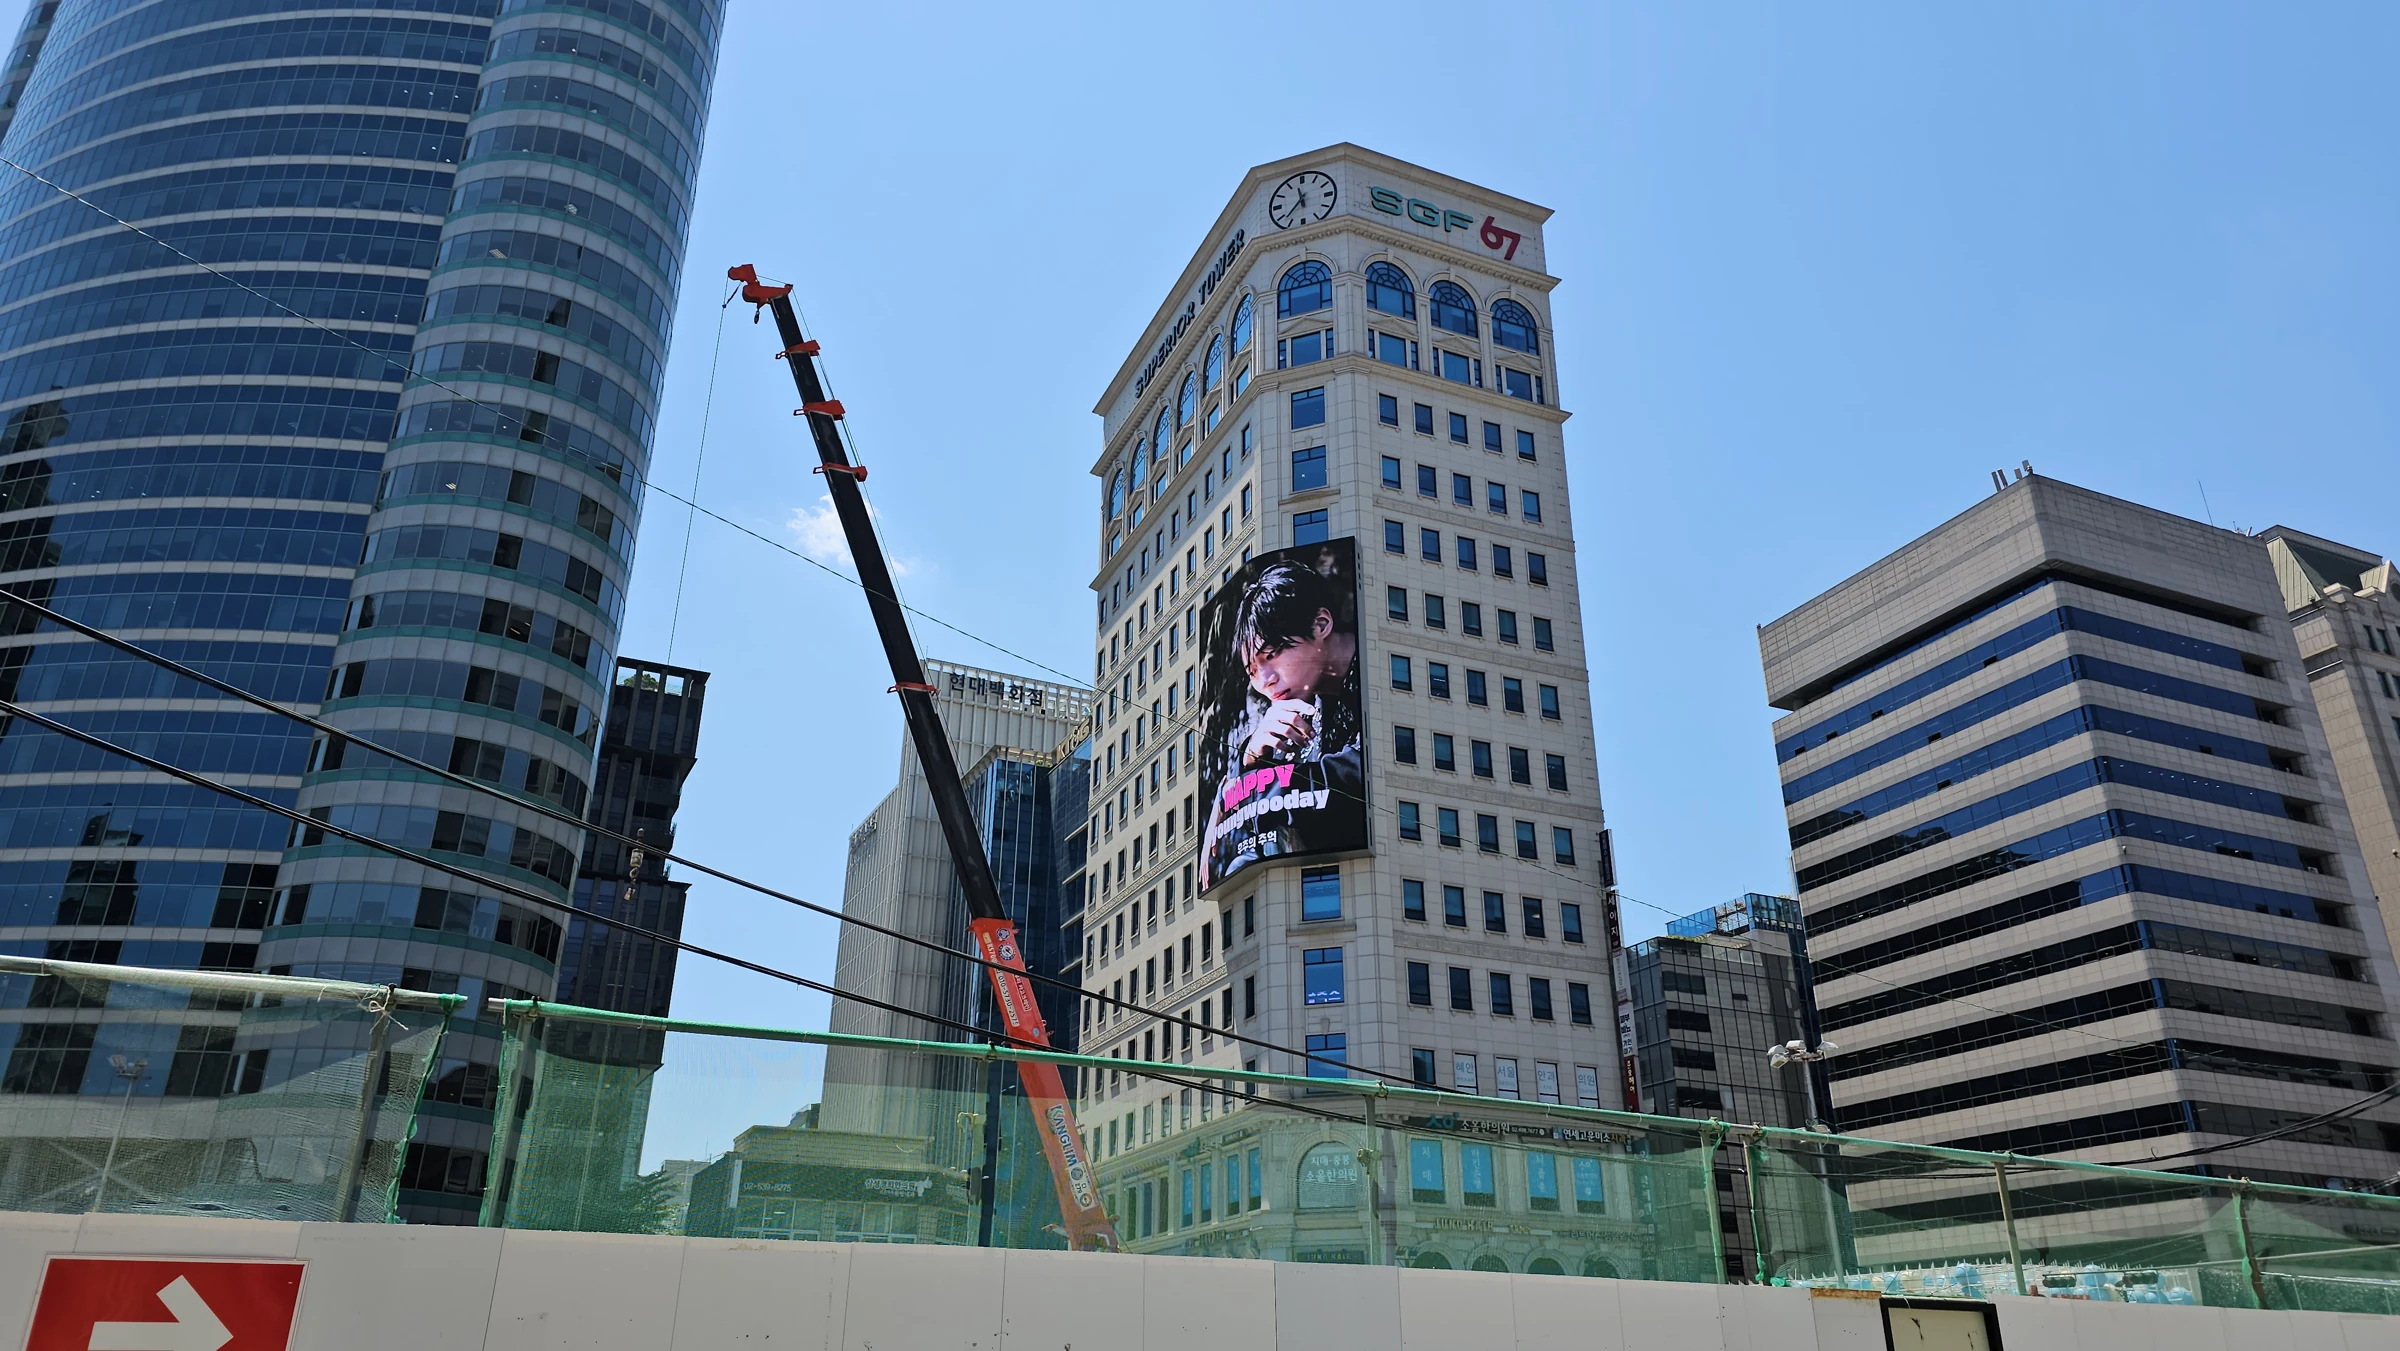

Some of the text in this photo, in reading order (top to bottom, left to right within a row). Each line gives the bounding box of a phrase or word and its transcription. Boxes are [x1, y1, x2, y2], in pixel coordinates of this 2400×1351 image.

[1371, 186, 1474, 232] SGF
[1135, 228, 1245, 398] SUPERIOR TOWER
[950, 671, 1043, 707] 현대백화점
[1224, 763, 1295, 813] HAPPY
[1258, 830, 1277, 846] 추억
[1455, 1062, 1596, 1087] 혜안 서울 안과 의원
[1050, 1103, 1078, 1167] KANGLIM
[1461, 1120, 1510, 1135] 소올한의원
